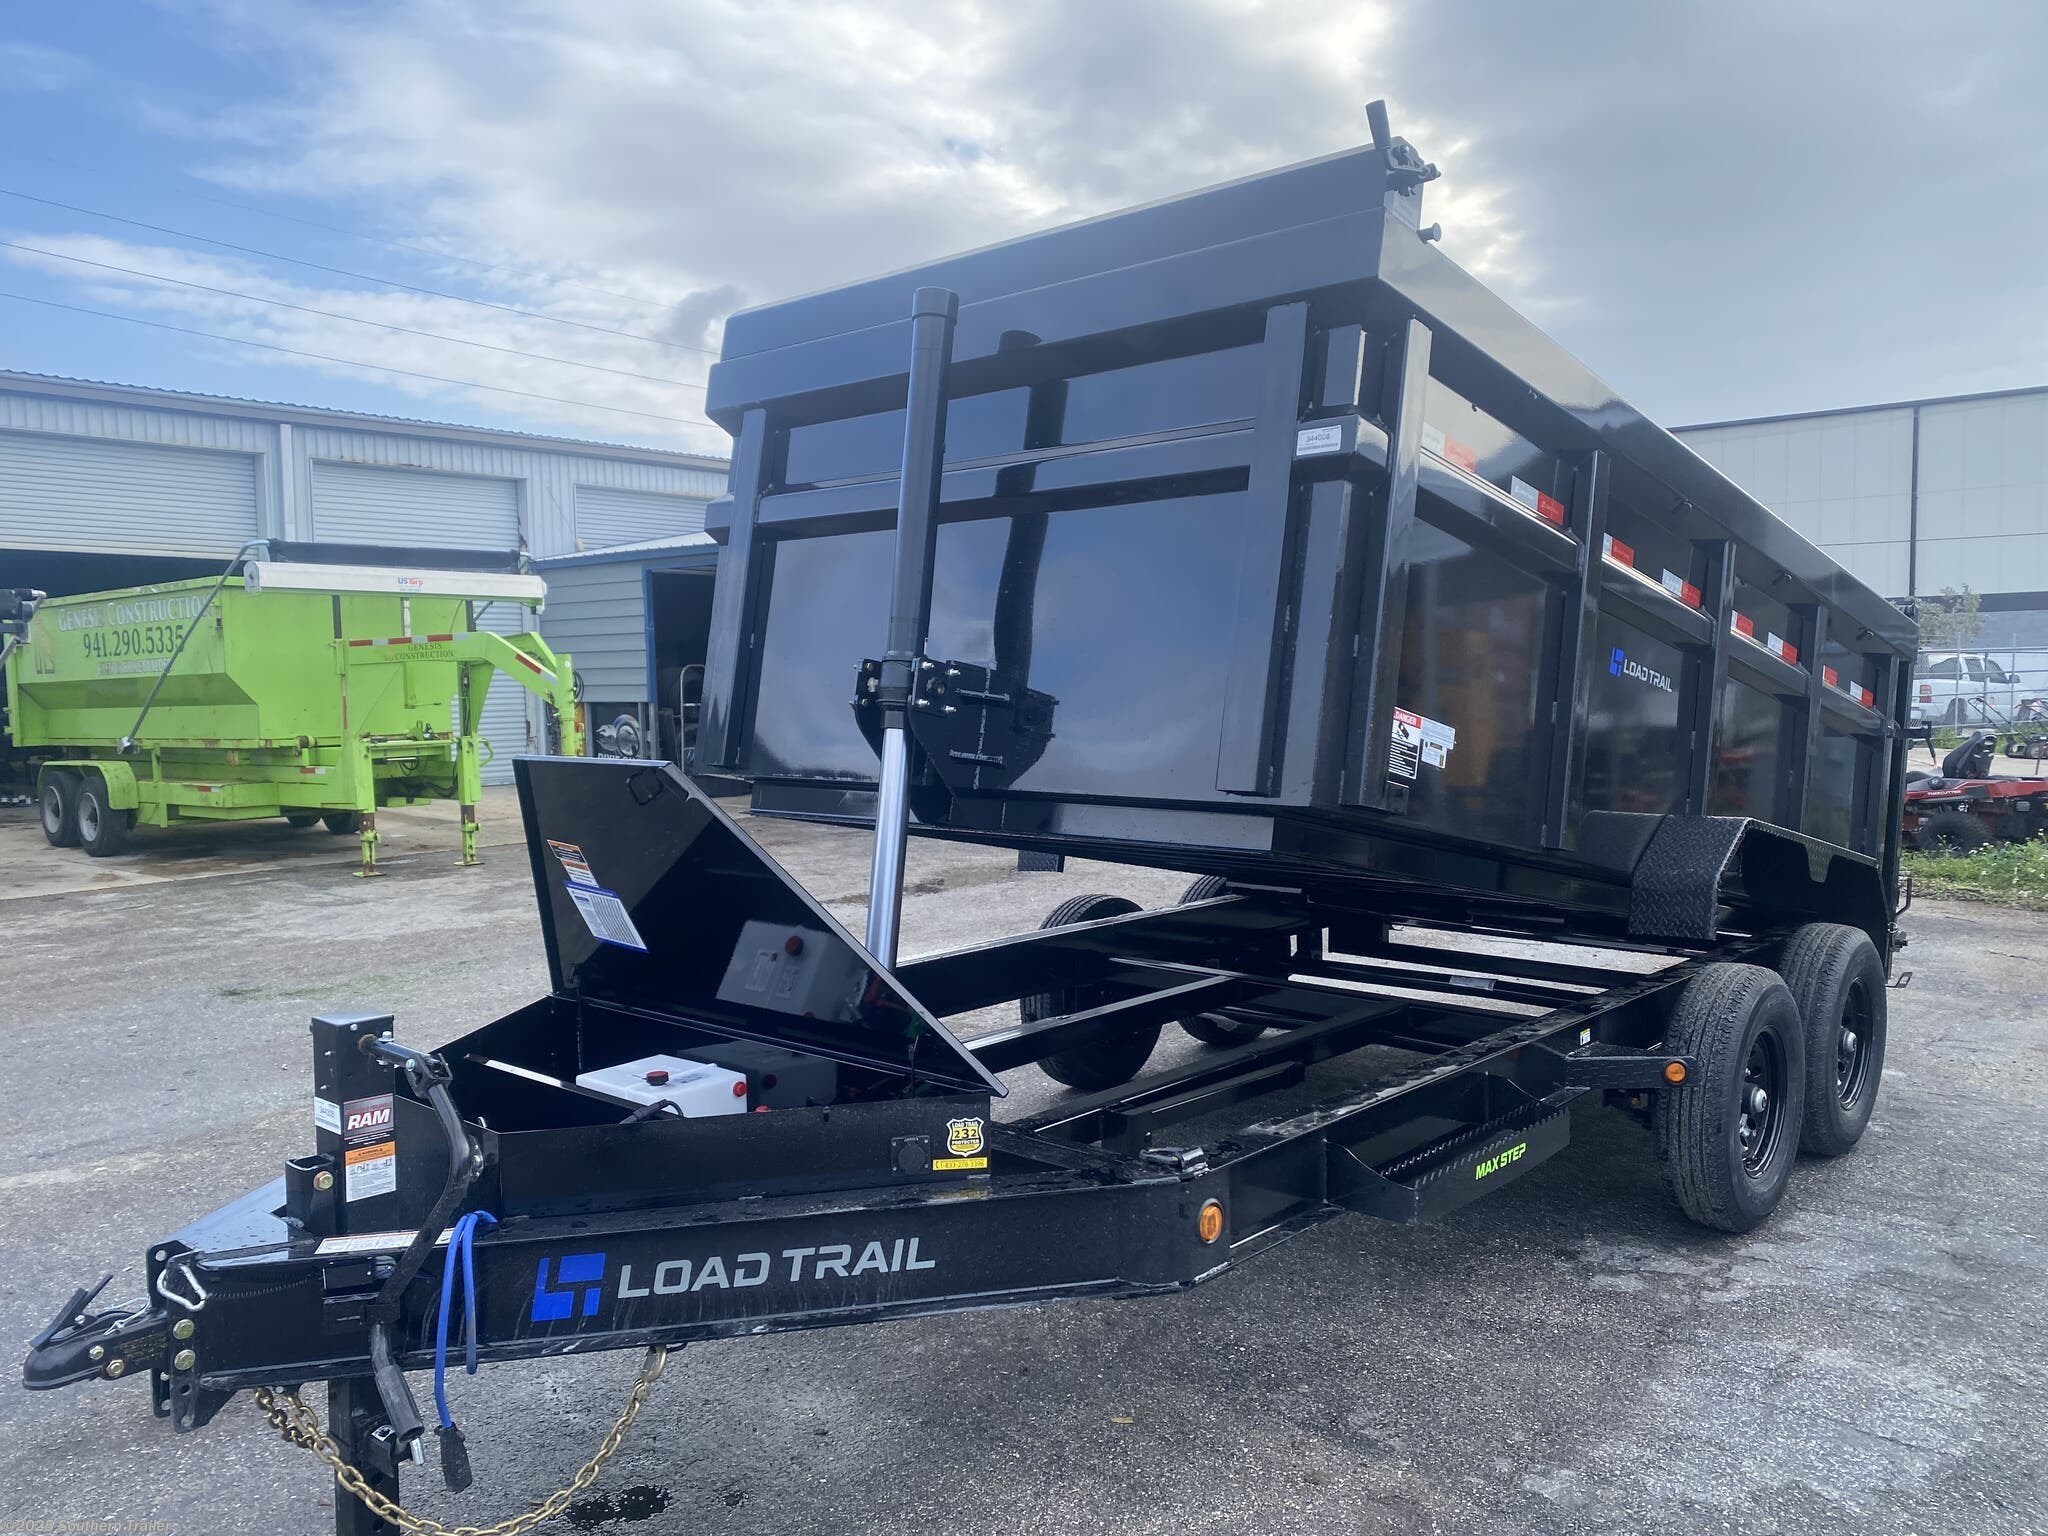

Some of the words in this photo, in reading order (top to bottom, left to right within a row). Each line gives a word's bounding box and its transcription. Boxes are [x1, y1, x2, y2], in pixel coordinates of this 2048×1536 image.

[83, 624, 184, 658] 941.290.5335
[394, 650, 454, 660] CONSTRUCTION
[408, 643, 442, 652] GENESIS
[1623, 658, 1649, 682] LOAD
[1649, 669, 1673, 693] TRAIL
[347, 1108, 391, 1131] RAM
[954, 1128, 977, 1139] 232
[1475, 1155, 1500, 1180] MAX
[1500, 1142, 1527, 1168] STEP
[617, 1252, 771, 1299] LOAD
[782, 1237, 936, 1282] TRAIL
